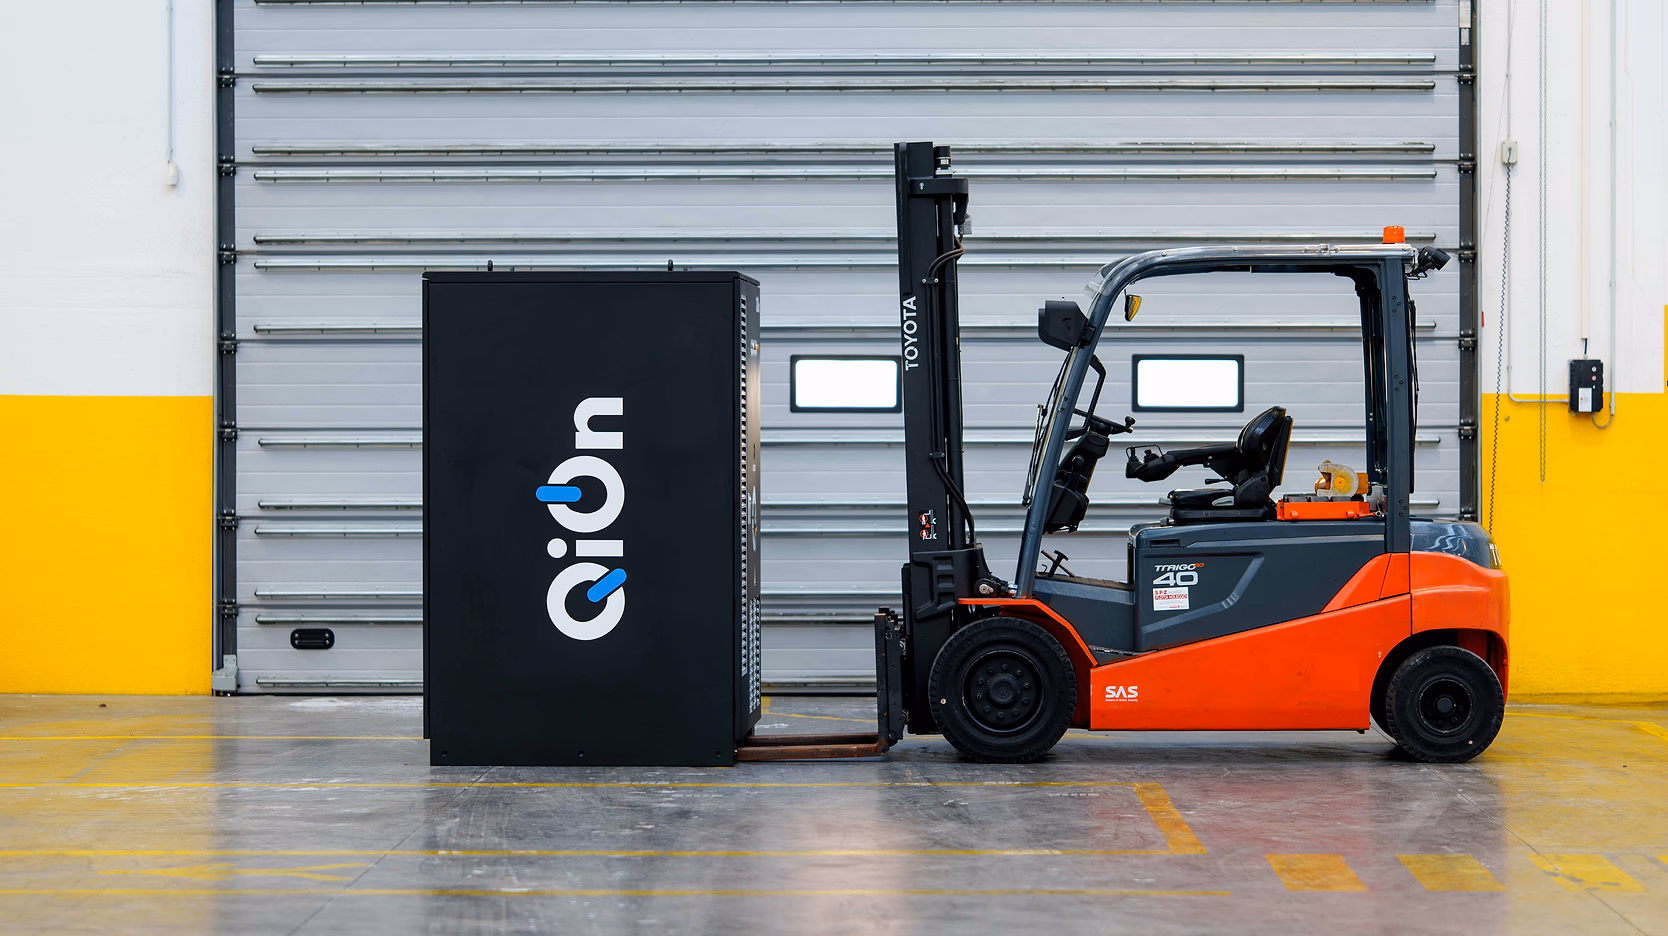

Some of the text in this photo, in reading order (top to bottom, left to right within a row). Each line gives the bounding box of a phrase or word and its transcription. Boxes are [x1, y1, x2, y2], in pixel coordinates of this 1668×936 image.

[902, 296, 919, 371] TOYOTA
[535, 397, 627, 641] QiOn
[1153, 571, 1198, 586] 40
[1106, 686, 1138, 698] SAS
